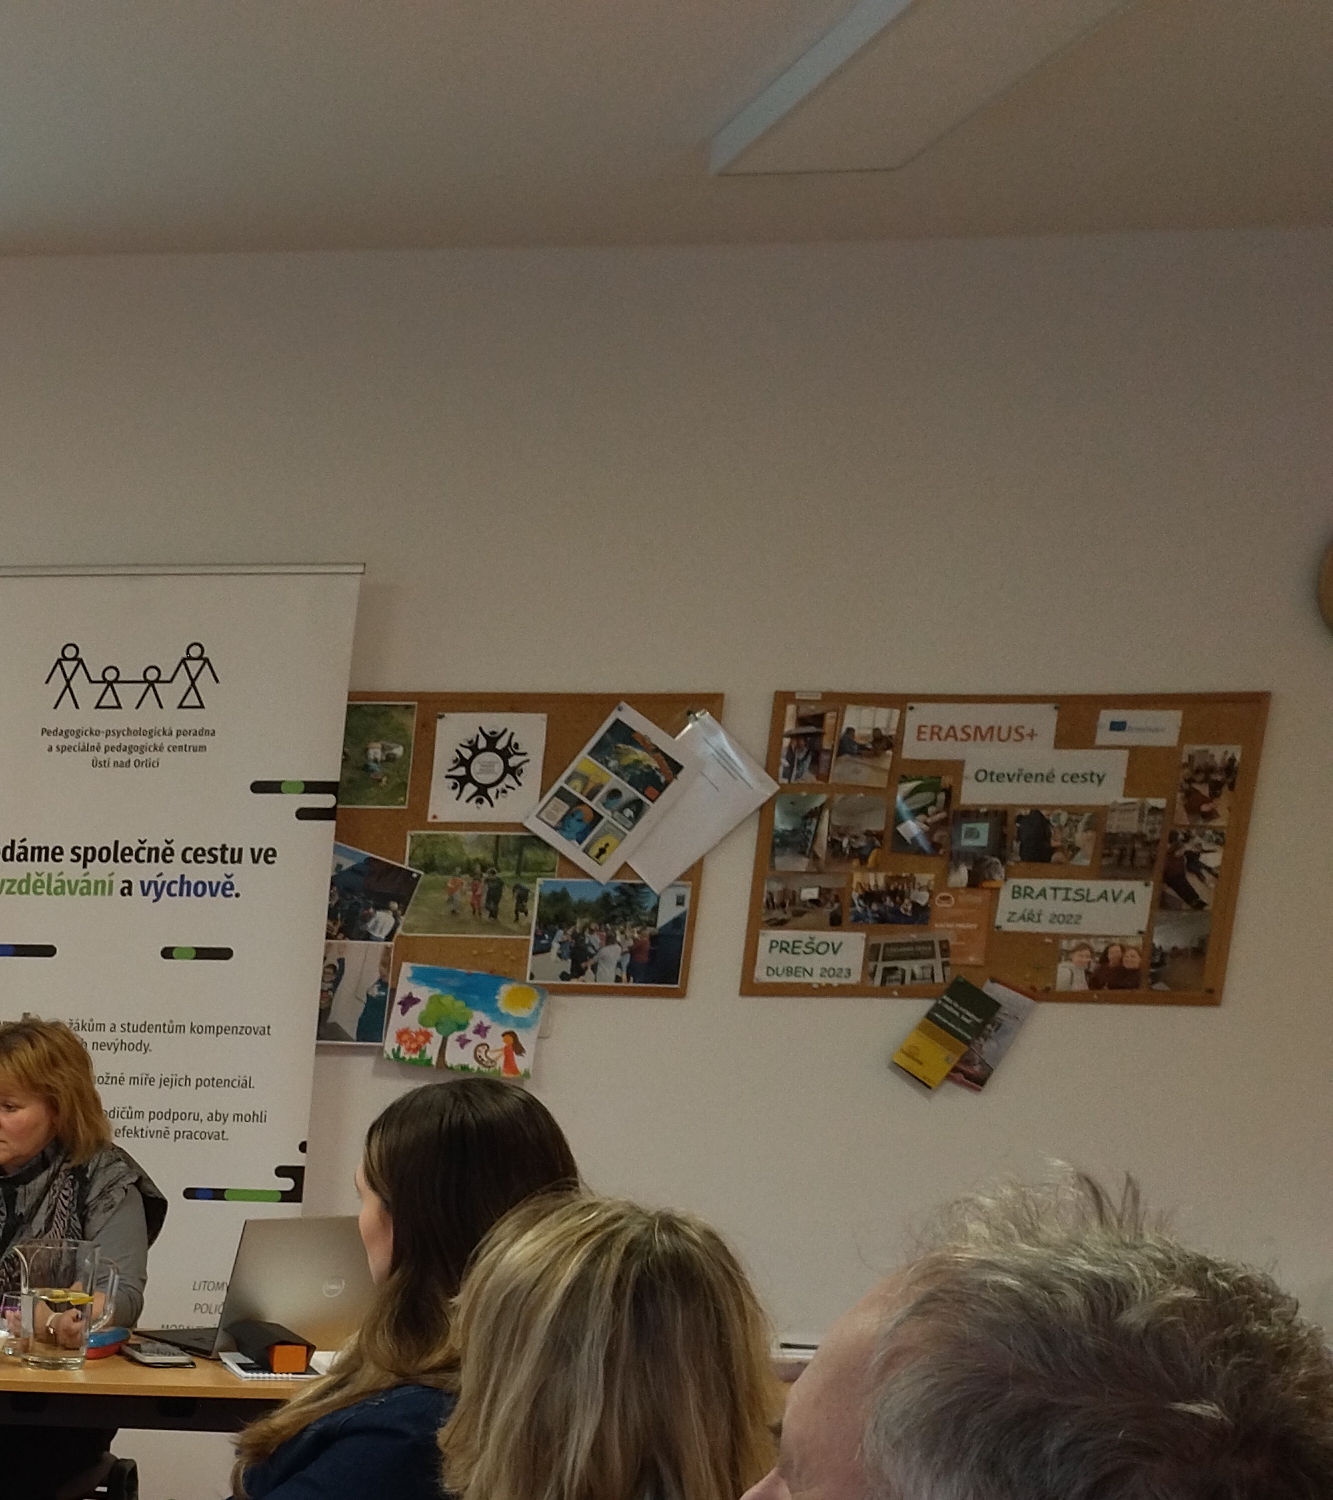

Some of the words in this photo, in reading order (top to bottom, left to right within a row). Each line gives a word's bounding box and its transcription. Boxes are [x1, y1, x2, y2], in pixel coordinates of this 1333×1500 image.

[41, 727, 173, 739] Pedagogicko-psychologická
[175, 727, 216, 739] poradna
[916, 724, 1039, 743] ERASMUS+
[47, 744, 54, 753] a
[55, 742, 101, 754] speciálně
[104, 742, 164, 755] pedagogické
[167, 743, 207, 753] centrum
[91, 756, 111, 769] Ústí
[113, 758, 131, 769] nad
[133, 758, 160, 769] Orlicí
[974, 767, 1056, 785] Otevřené
[1060, 771, 1107, 788] cesty
[70, 838, 175, 869] společně
[180, 843, 244, 866] cestu
[250, 846, 278, 866] ve
[119, 880, 134, 898] a
[139, 872, 241, 904] výchově.
[1011, 885, 1137, 904] BRATISLAVA
[1006, 910, 1043, 924] ZÁŘÍ
[1047, 913, 1083, 926] 2022
[768, 934, 844, 957] PREŠOV
[765, 965, 816, 979] DUBEN
[819, 966, 853, 980] 2023
[109, 1023, 117, 1034] a
[120, 1019, 186, 1035] studentům
[189, 1022, 272, 1038] kompenzovat
[91, 1038, 153, 1055] nevýhody.
[95, 1073, 126, 1087] ožné
[129, 1073, 156, 1087] míře
[159, 1074, 192, 1090] jejich
[195, 1075, 255, 1091] potenciál.
[104, 1104, 146, 1120] odičům
[148, 1107, 203, 1124] podporu,
[206, 1108, 229, 1125] aby
[232, 1108, 268, 1124] mohli
[114, 1126, 171, 1141] efektivně
[173, 1127, 229, 1142] pracovat.
[192, 1280, 229, 1292] LITOMY
